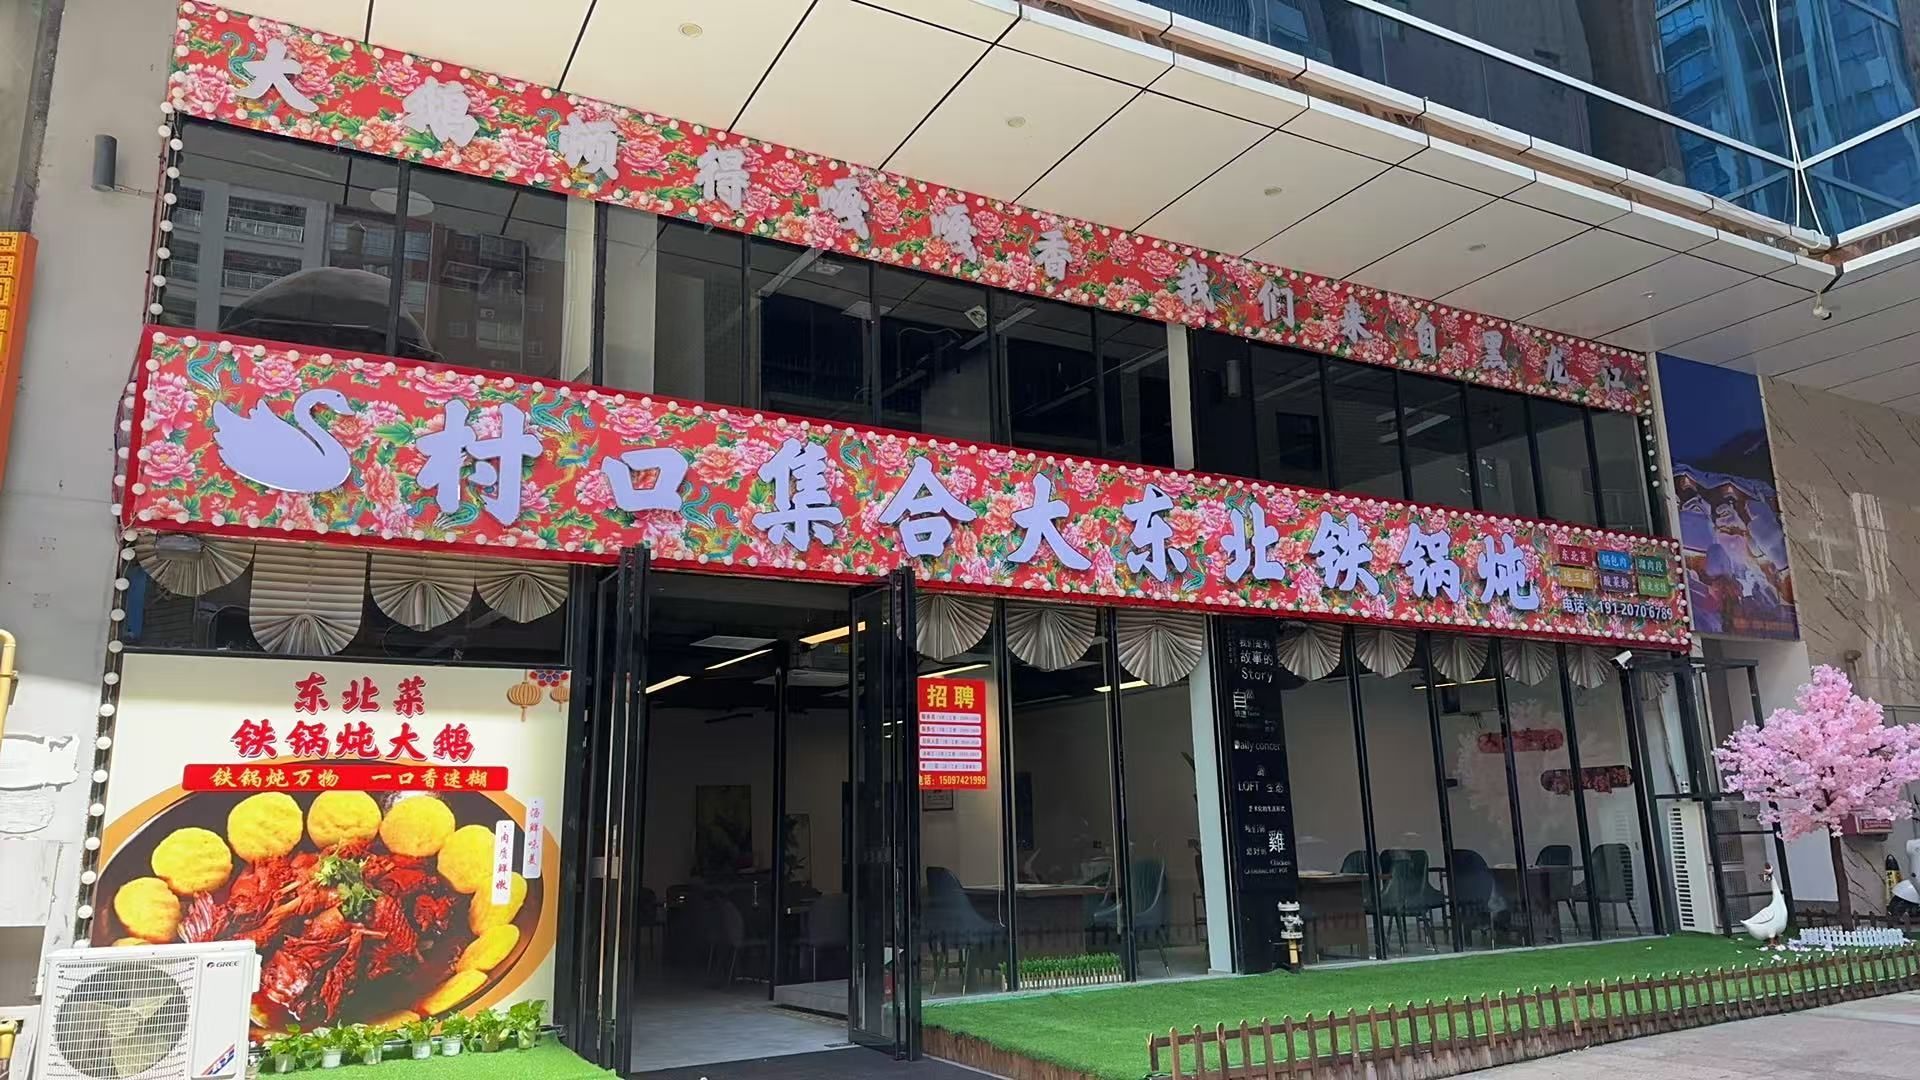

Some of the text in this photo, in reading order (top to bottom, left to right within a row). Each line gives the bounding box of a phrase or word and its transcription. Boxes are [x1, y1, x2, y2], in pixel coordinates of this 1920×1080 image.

[415, 398, 1540, 611] 村口集合大东北铁锅炖
[1561, 549, 1588, 563] 东北菜
[1241, 667, 1273, 683] Story
[293, 671, 427, 718] 东北菜
[927, 684, 974, 709] 招聘
[231, 718, 475, 763] 铁锅炖大鹅
[209, 767, 488, 789] 铁锅炖万物 一口香迷糊
[939, 775, 986, 785] 15097421999
[495, 832, 509, 890] 肉质鲜嫩
